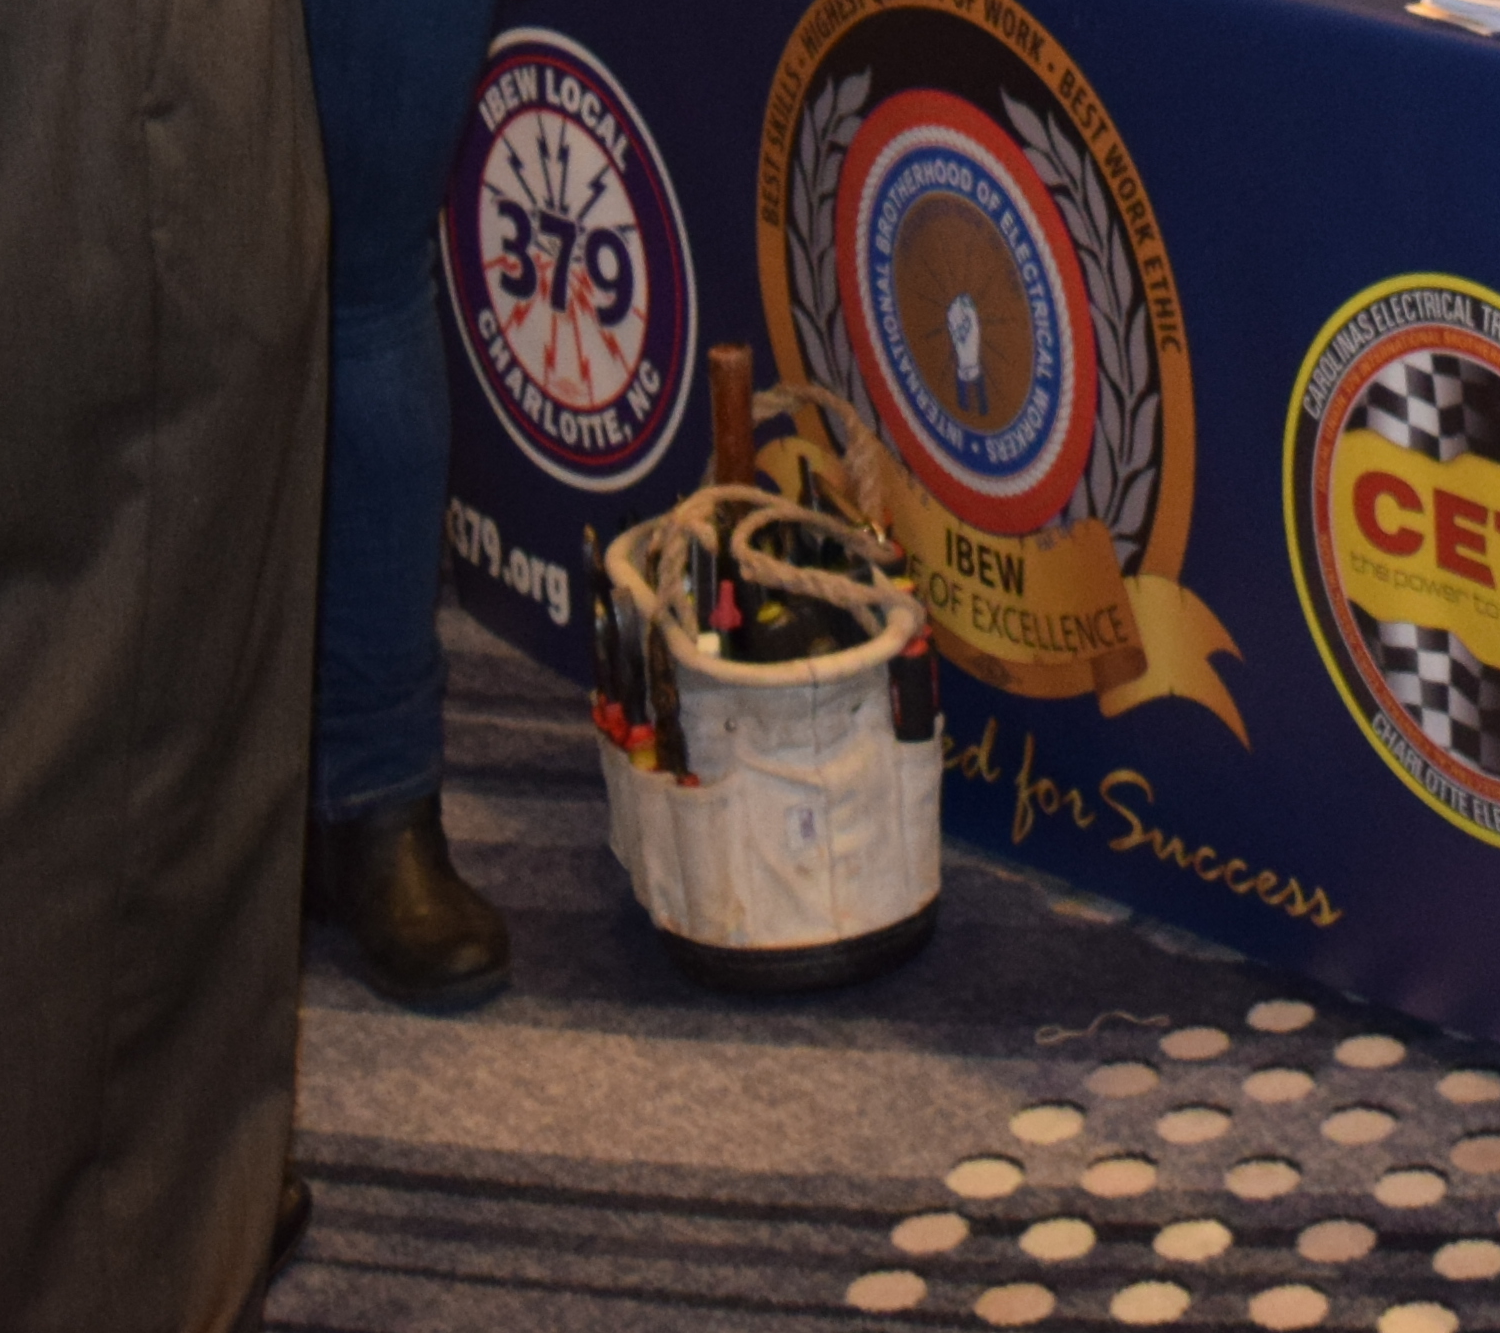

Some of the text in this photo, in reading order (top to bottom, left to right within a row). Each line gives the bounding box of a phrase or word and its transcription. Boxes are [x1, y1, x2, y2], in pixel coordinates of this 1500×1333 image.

[477, 64, 631, 171] IBEW LOCAL
[497, 199, 635, 327] 379
[761, 159, 782, 228] BEST
[772, 60, 801, 156] SKILLS
[1058, 68, 1110, 135] BEST
[1103, 143, 1156, 246] WORK
[1144, 256, 1182, 354] ETHIC
[873, 158, 1055, 464] INTERNATIONAL BROTHERHOOD OF ELECTRICAL WORKERS
[1302, 312, 1376, 420] CAROLINAS
[1372, 289, 1476, 335] ELECTRICAL
[476, 306, 661, 449] CHARLOTTE, NC
[929, 575, 1130, 655] OF EXCELLENCE
[945, 529, 1027, 598] IBEW
[1349, 549, 1390, 584] the
[1393, 565, 1470, 608] power
[1472, 591, 1499, 623] to
[1370, 710, 1468, 820] CHARLOTTE
[1012, 731, 1097, 846] for
[1100, 768, 1345, 928] Success
